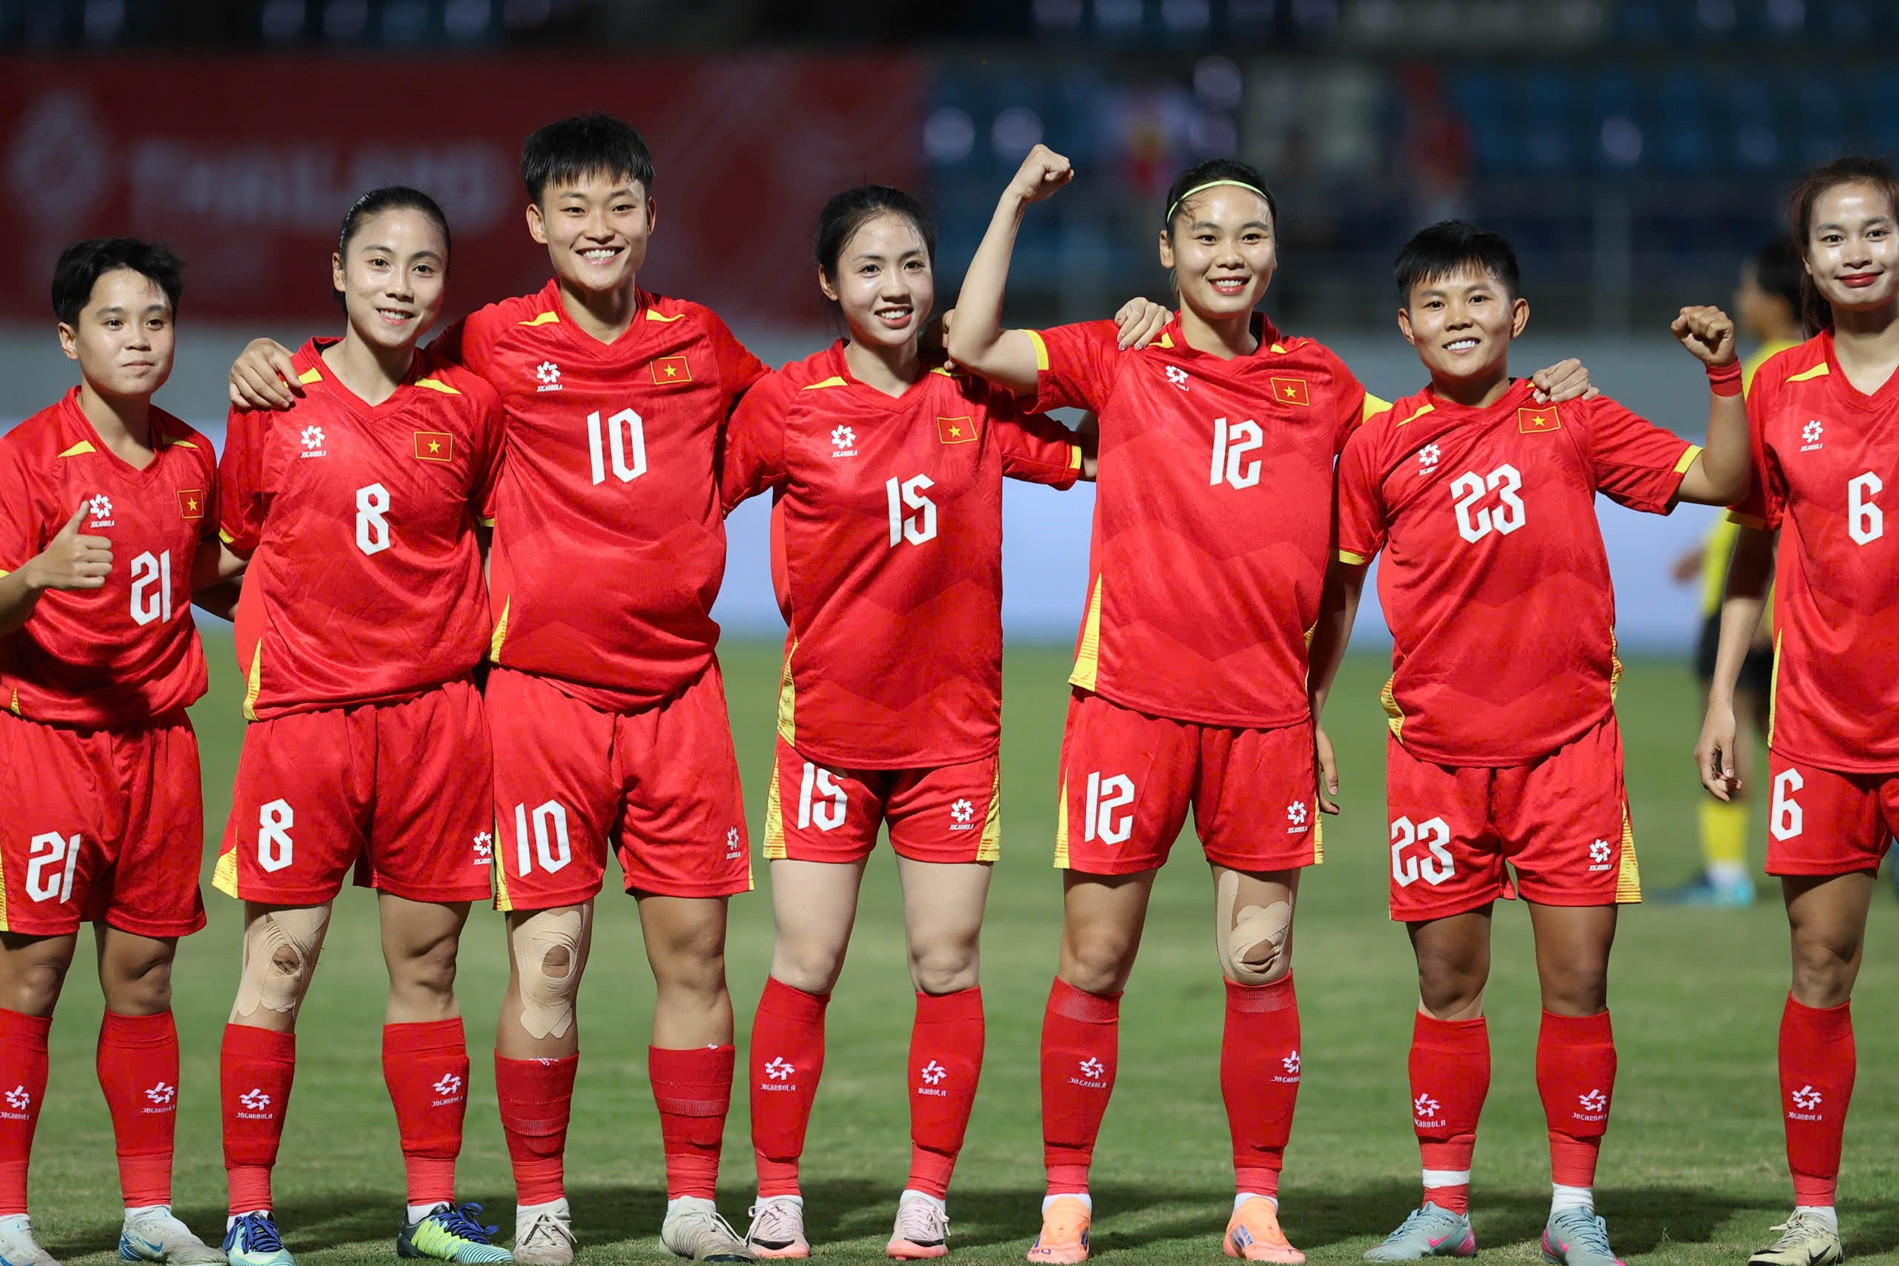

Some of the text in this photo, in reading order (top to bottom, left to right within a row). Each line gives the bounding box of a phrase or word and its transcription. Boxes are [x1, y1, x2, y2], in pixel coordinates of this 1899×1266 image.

[587, 408, 647, 485] 10
[1210, 418, 1263, 490] 12
[356, 483, 390, 555] 8
[886, 474, 936, 547] 15
[1450, 464, 1525, 543] 23
[1848, 471, 1883, 545] 6
[131, 550, 170, 625] 21
[798, 762, 847, 831] 15
[1085, 772, 1134, 845] 12
[1771, 768, 1803, 841] 6
[26, 832, 80, 903] 21
[258, 799, 293, 872] 8
[515, 800, 571, 877] 10
[1392, 816, 1455, 887] 23
